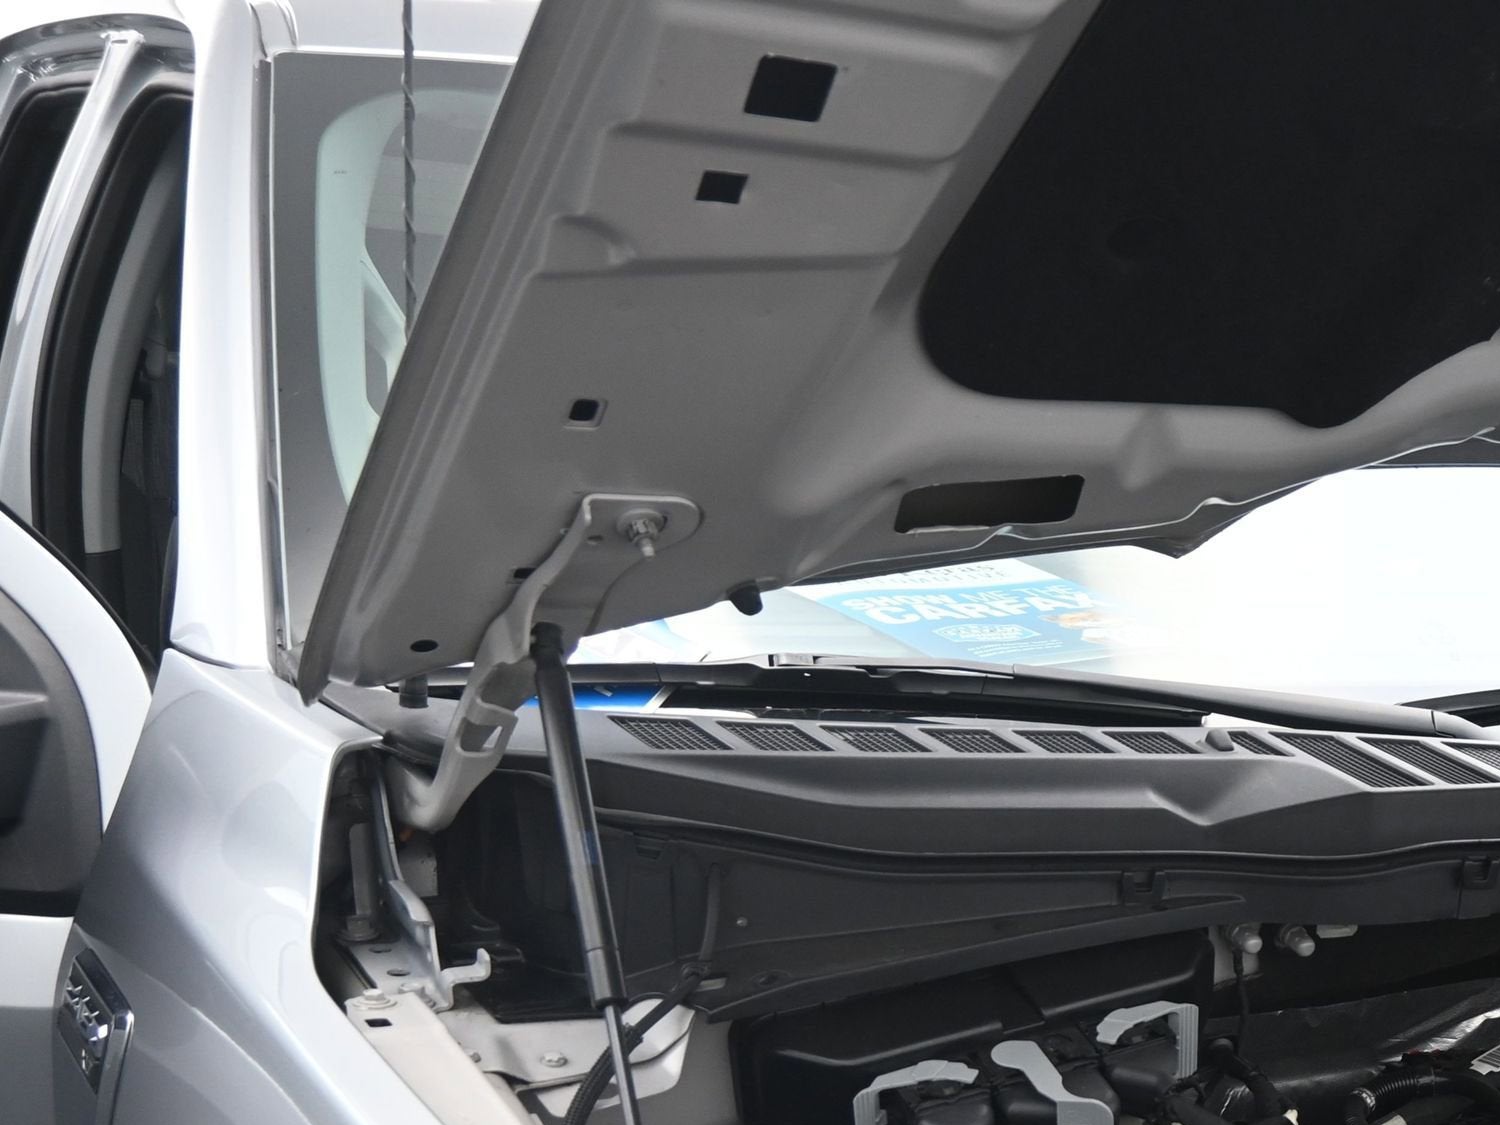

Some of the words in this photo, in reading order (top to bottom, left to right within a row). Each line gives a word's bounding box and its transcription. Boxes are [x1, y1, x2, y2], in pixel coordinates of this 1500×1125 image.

[842, 593, 957, 611] SHOW
[959, 589, 1019, 602] ME
[1017, 585, 1078, 597] THE
[865, 592, 1107, 624] CARFAX
